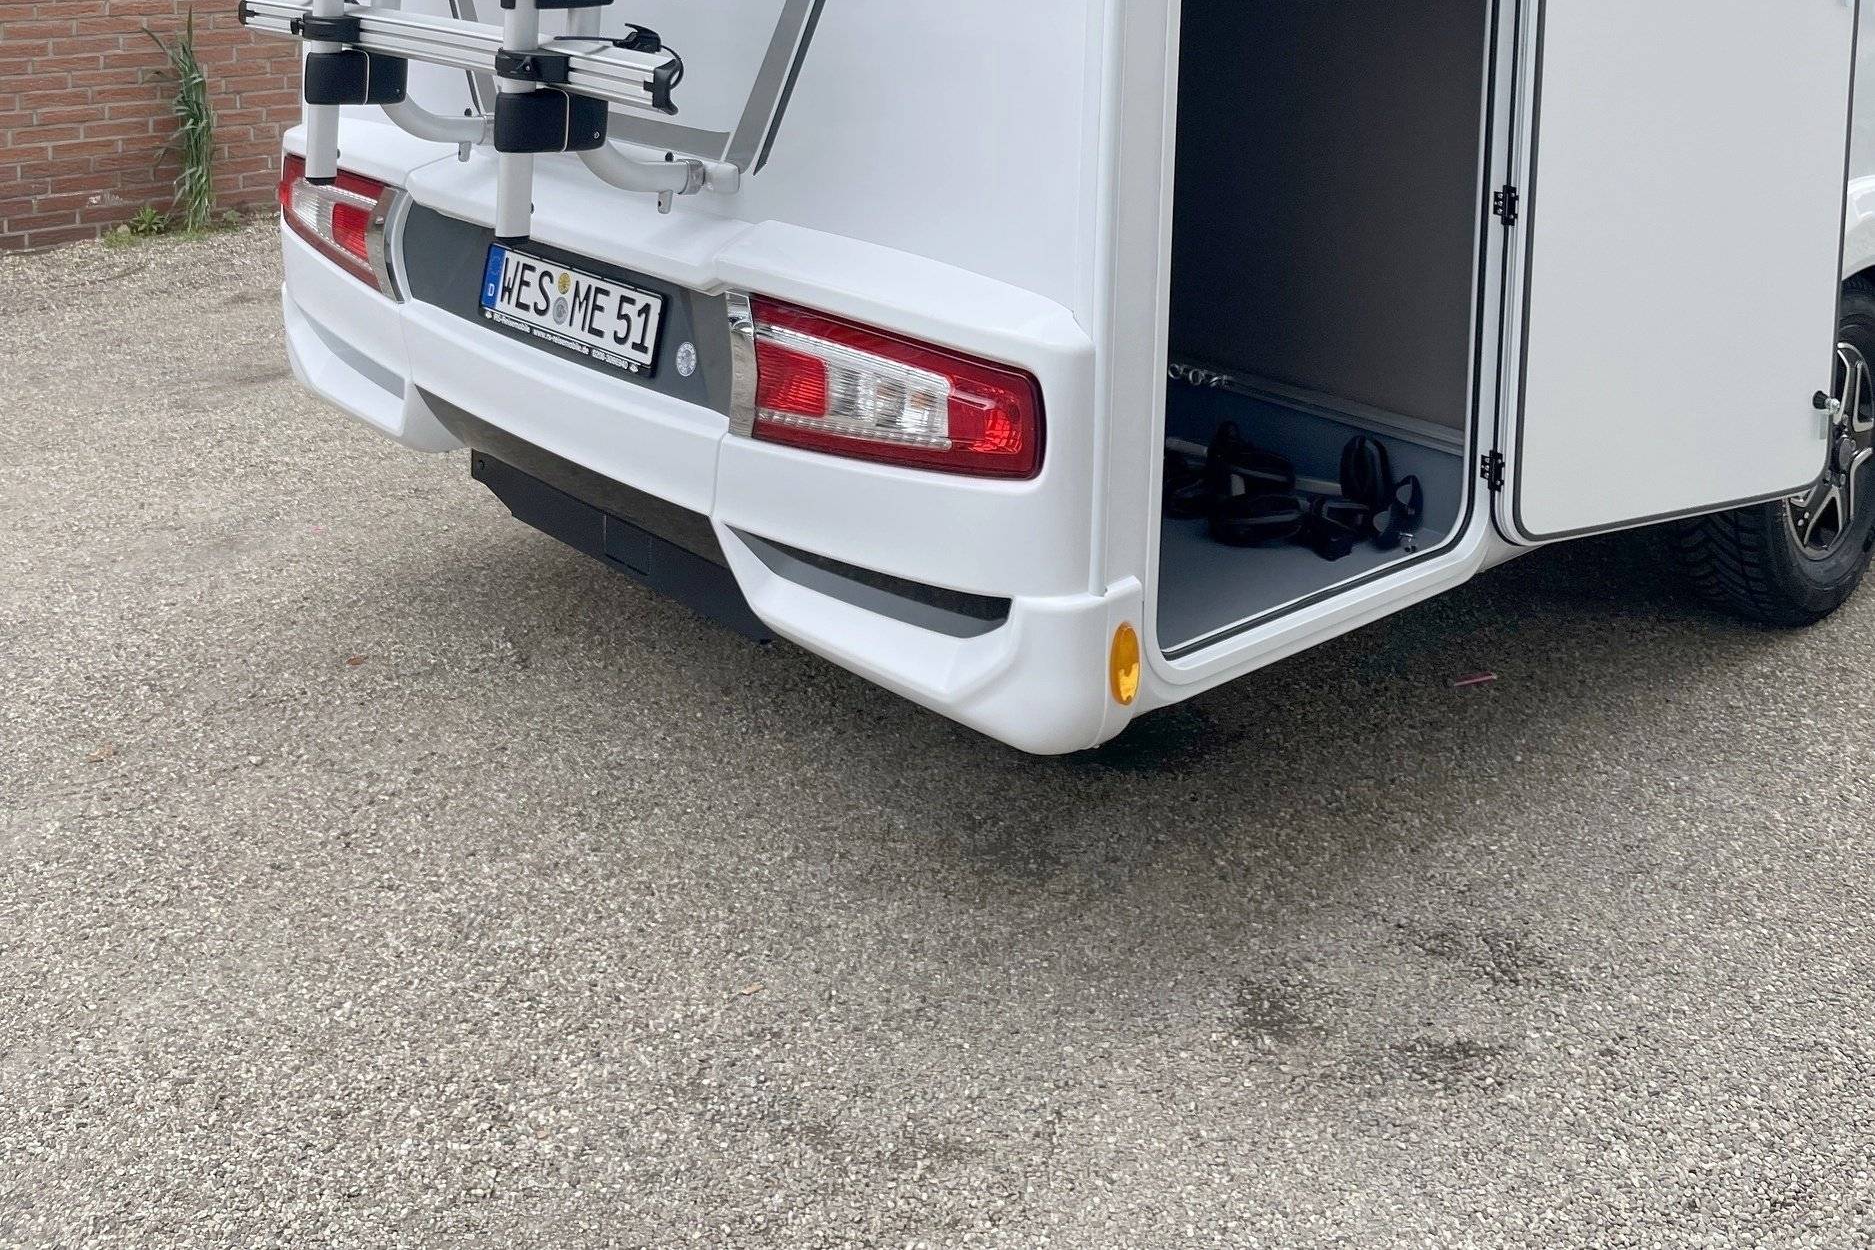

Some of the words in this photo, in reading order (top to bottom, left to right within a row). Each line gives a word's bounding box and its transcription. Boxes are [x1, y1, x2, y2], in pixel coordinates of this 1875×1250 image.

[500, 258, 554, 316] WES
[568, 280, 611, 338] ME
[613, 294, 652, 354] 51
